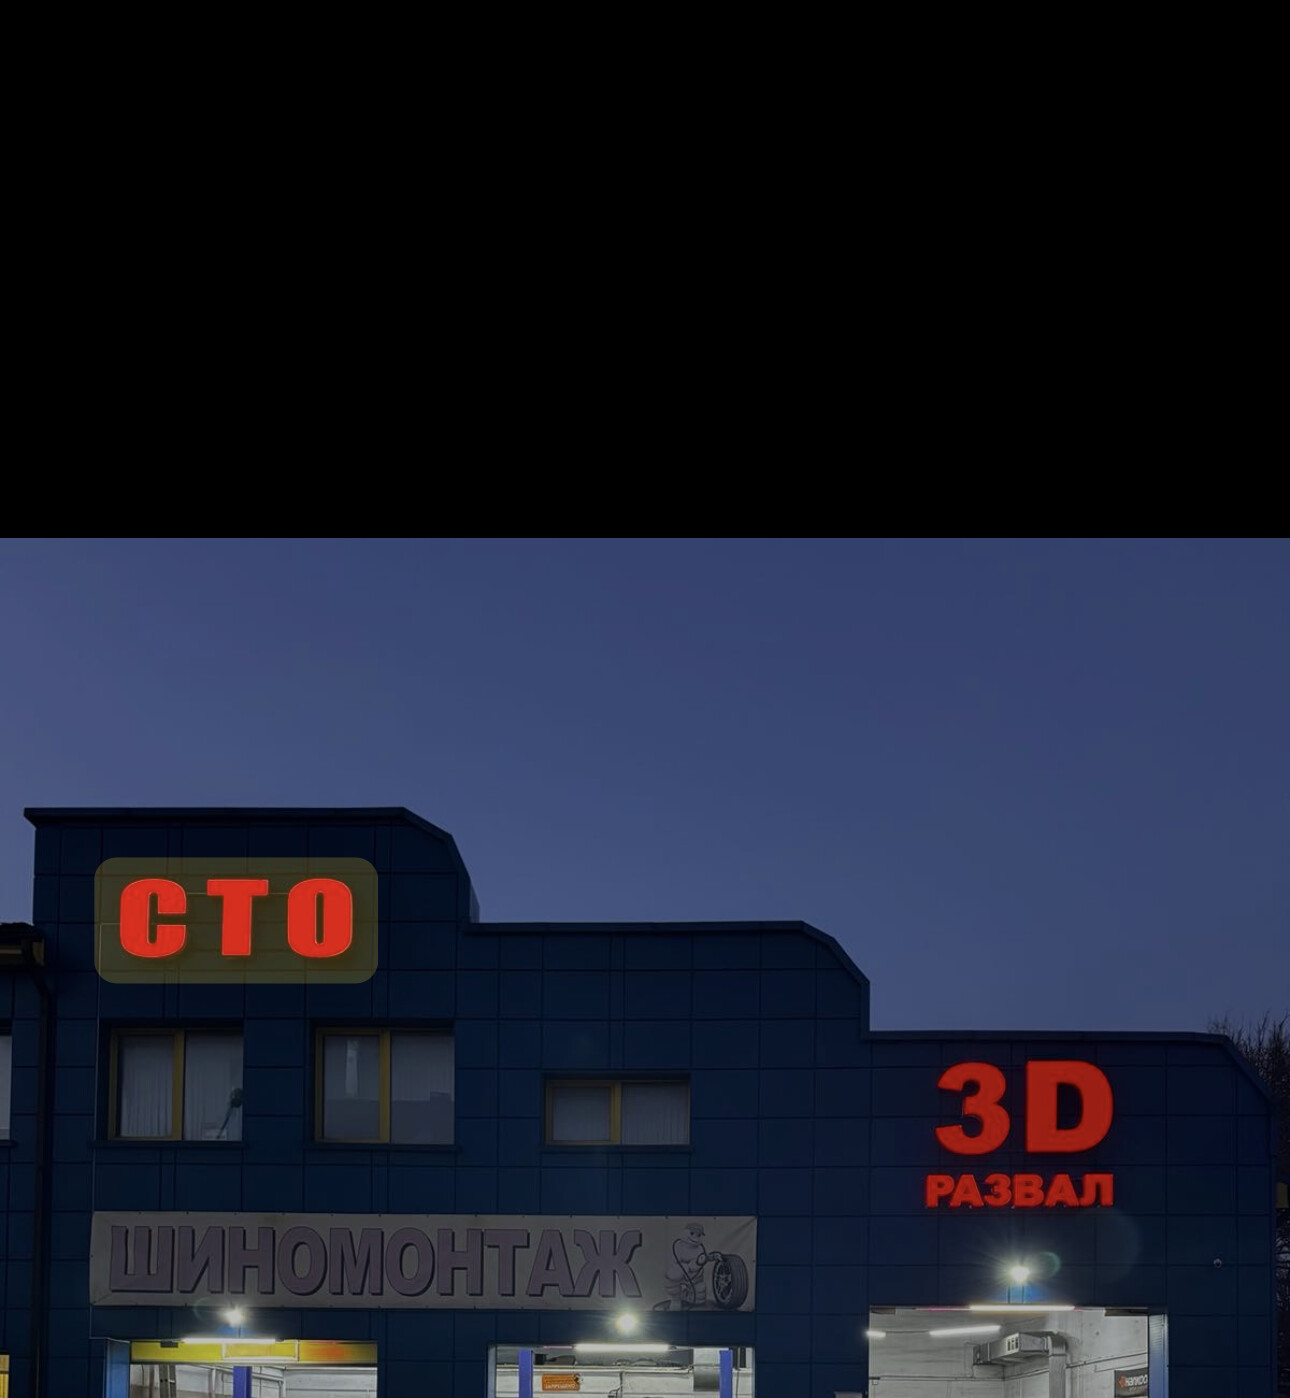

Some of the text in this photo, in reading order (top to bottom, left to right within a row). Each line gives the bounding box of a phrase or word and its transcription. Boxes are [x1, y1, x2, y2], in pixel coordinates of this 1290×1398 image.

[118, 877, 354, 959] СТО
[935, 1058, 1114, 1155] 3D
[925, 1173, 1114, 1208] РАЗВАЛ
[110, 1225, 643, 1299] ШИНОМОНТАЖ
